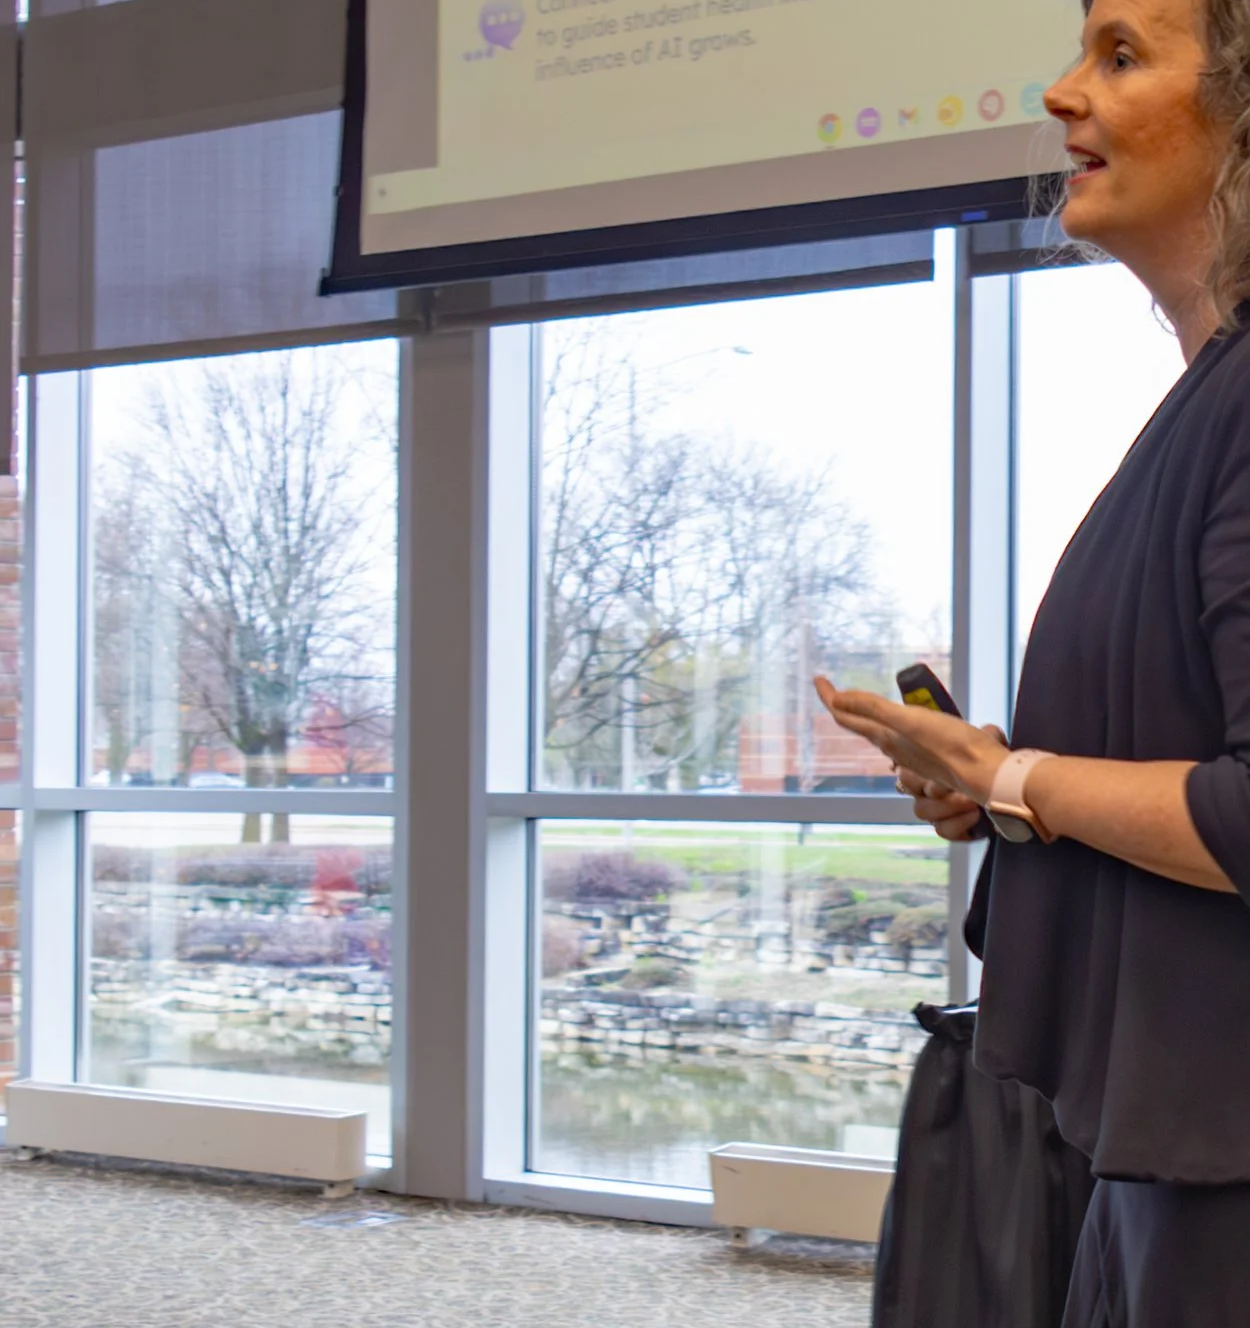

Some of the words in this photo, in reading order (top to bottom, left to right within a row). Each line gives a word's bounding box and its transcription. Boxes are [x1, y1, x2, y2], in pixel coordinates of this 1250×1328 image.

[536, 27, 557, 48] to
[561, 16, 618, 49] guide
[623, 1, 702, 30] student
[535, 54, 626, 82] influence
[631, 40, 654, 65] of
[656, 36, 683, 61] AI
[688, 28, 756, 62] grows.
